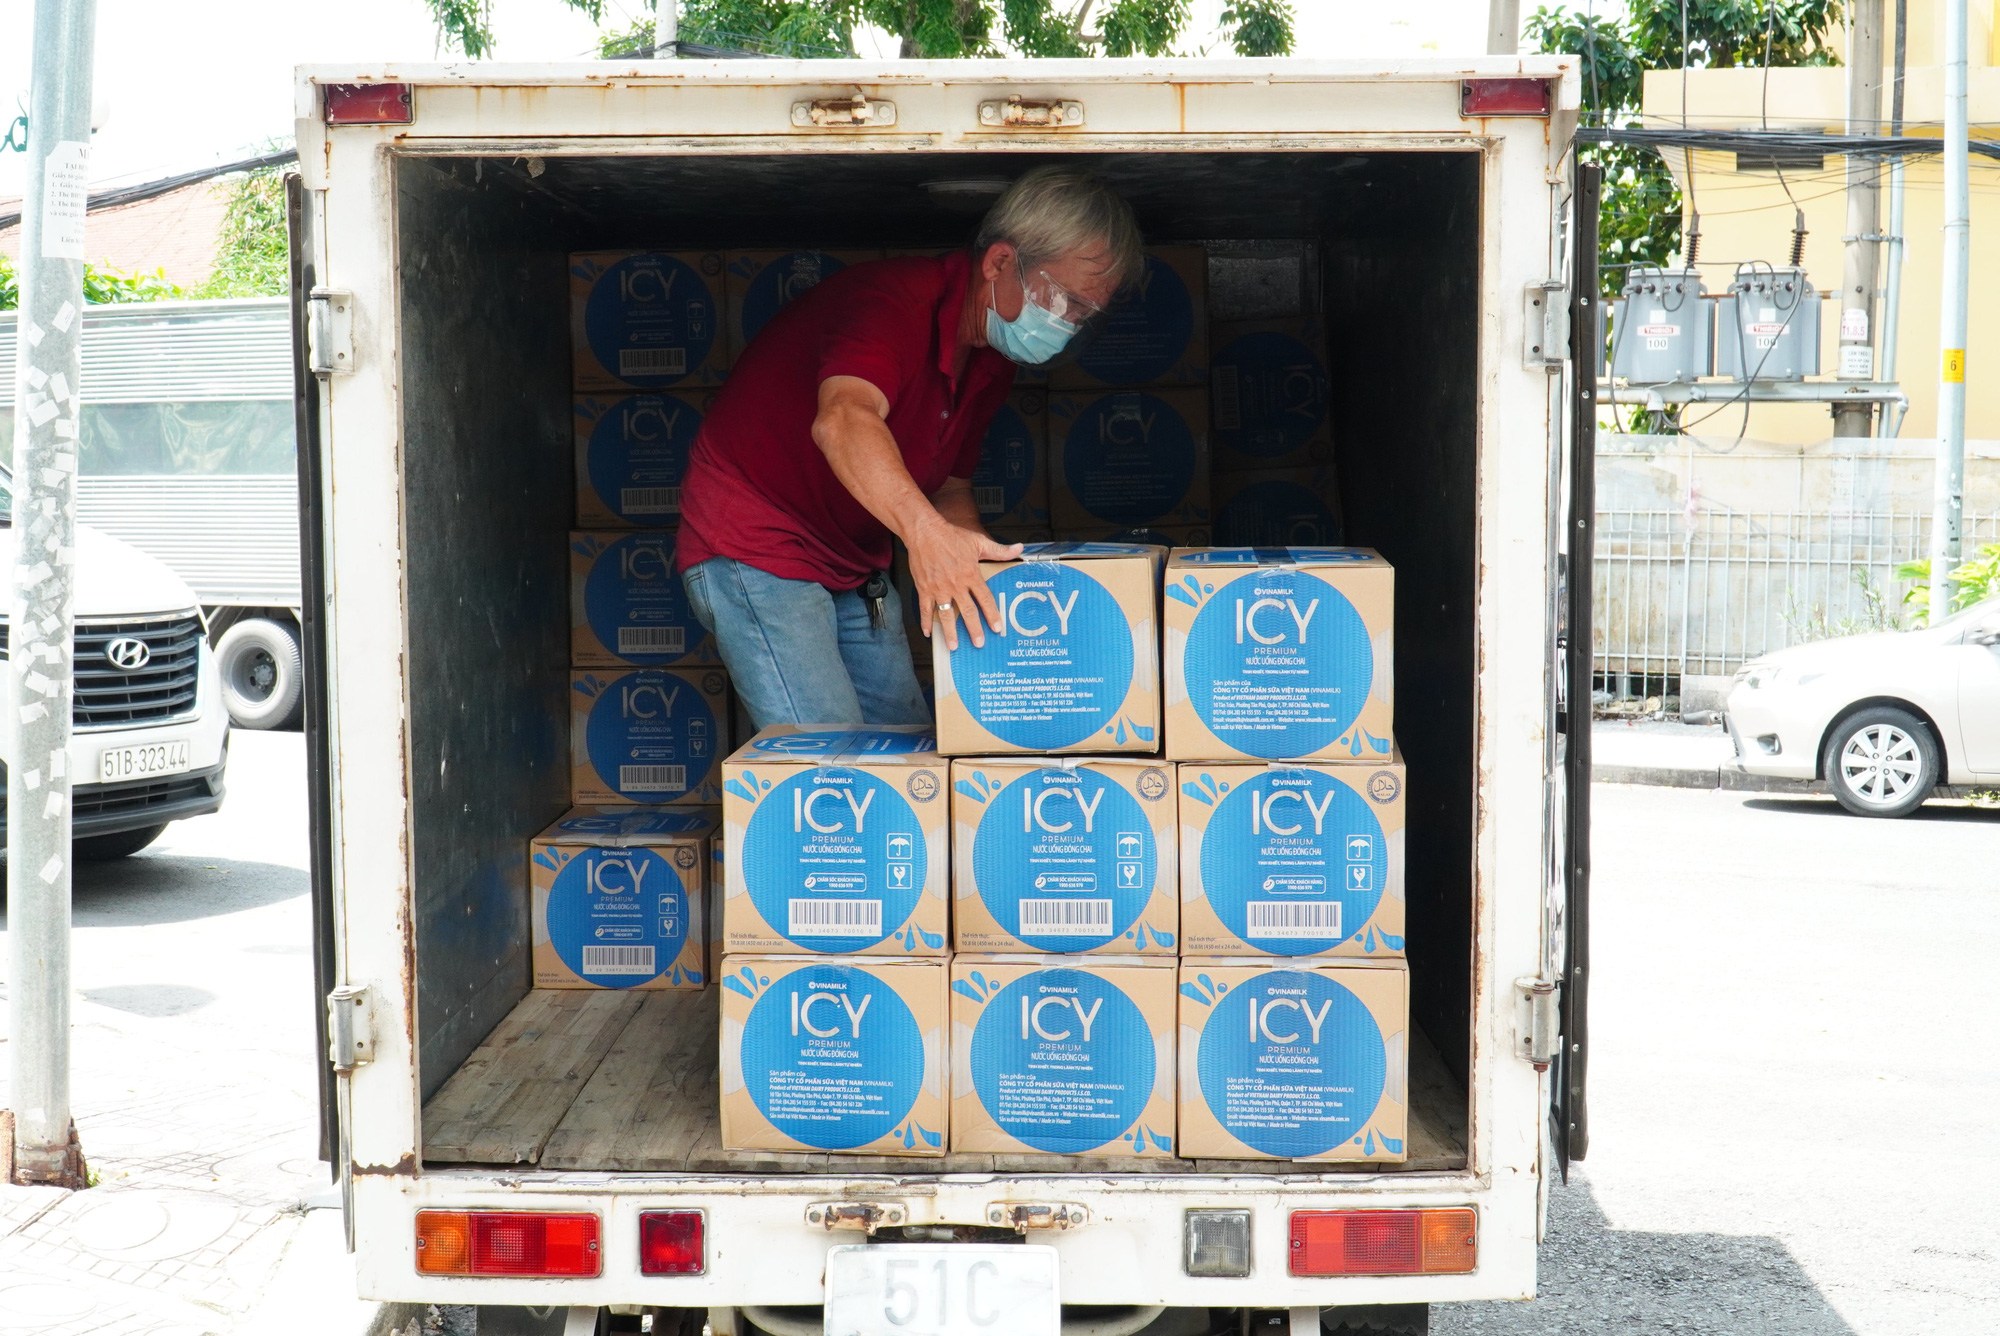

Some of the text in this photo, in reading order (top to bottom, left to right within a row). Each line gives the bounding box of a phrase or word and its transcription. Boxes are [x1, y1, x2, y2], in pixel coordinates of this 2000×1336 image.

[622, 268, 679, 302] ICY
[1649, 339, 1666, 348] 100
[1950, 360, 1957, 371] 6
[624, 408, 681, 441] ICY
[1098, 412, 1155, 445] ICY
[622, 548, 677, 579] ICY
[998, 590, 1081, 637] ICY
[1236, 598, 1319, 644] ICY
[623, 687, 681, 718] ICY
[105, 744, 186, 776] 51B-323.44
[794, 789, 876, 834] ICY
[1024, 788, 1105, 833] ICY
[1252, 789, 1337, 835] ICY
[791, 992, 872, 1039] ICY
[1022, 996, 1103, 1042] ICY
[1250, 999, 1333, 1044] ICY
[885, 1259, 1000, 1326] 51C
